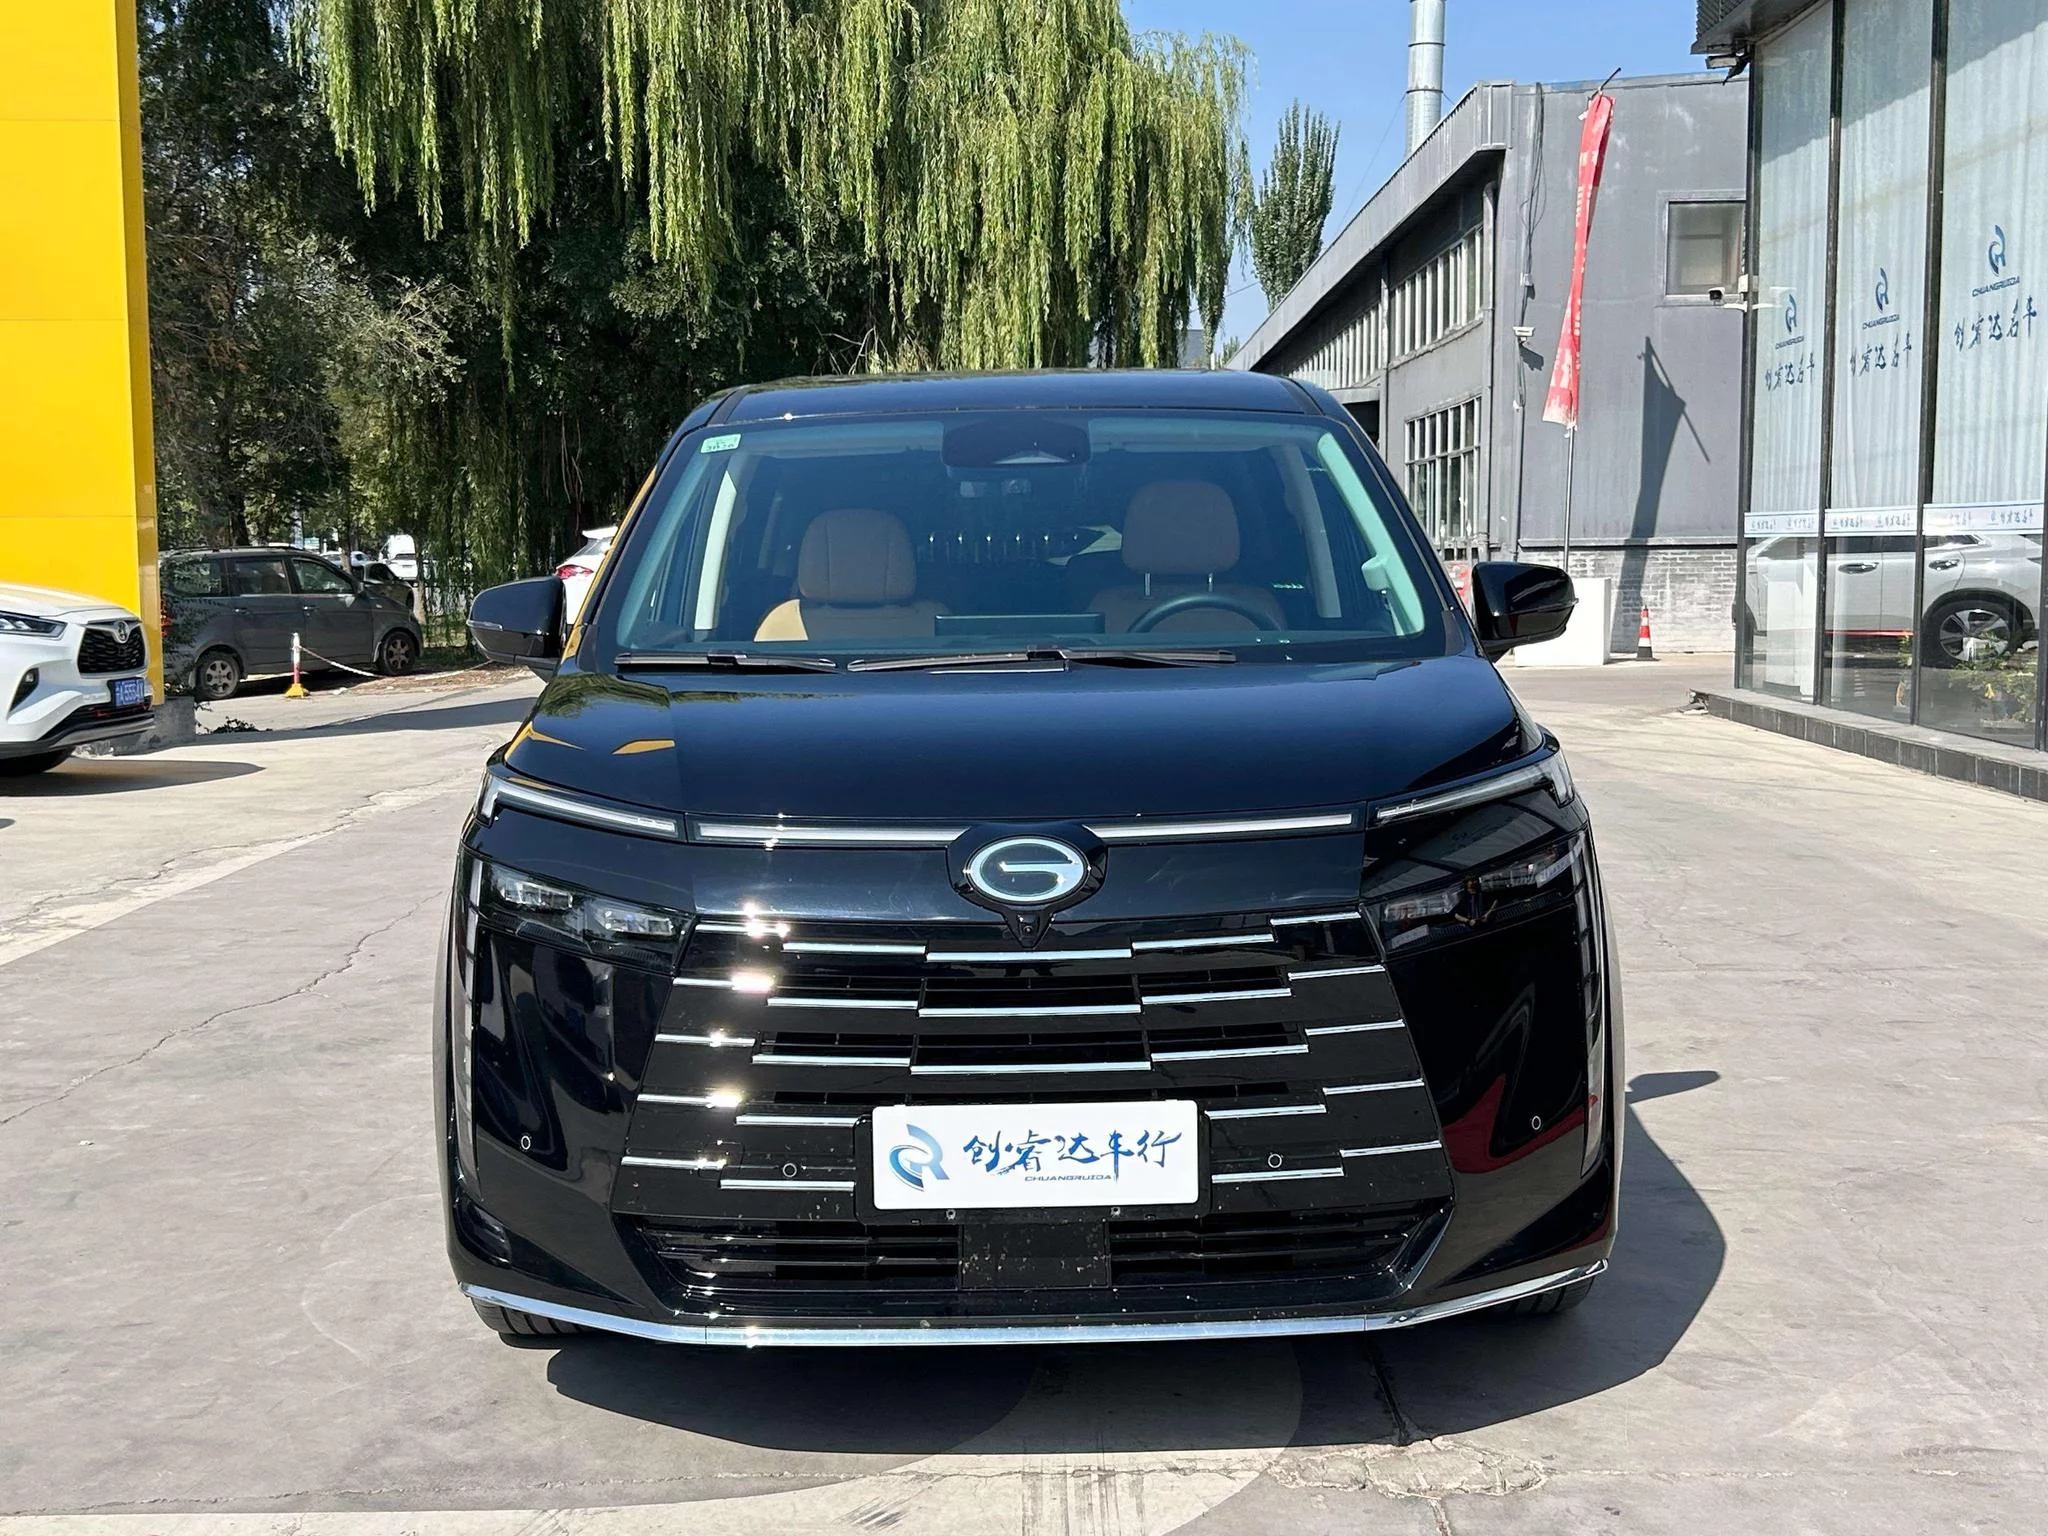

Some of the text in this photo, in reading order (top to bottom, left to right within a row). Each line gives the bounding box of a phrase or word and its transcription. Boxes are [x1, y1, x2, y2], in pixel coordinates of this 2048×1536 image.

[963, 1130, 1182, 1183] 创睿达车行
